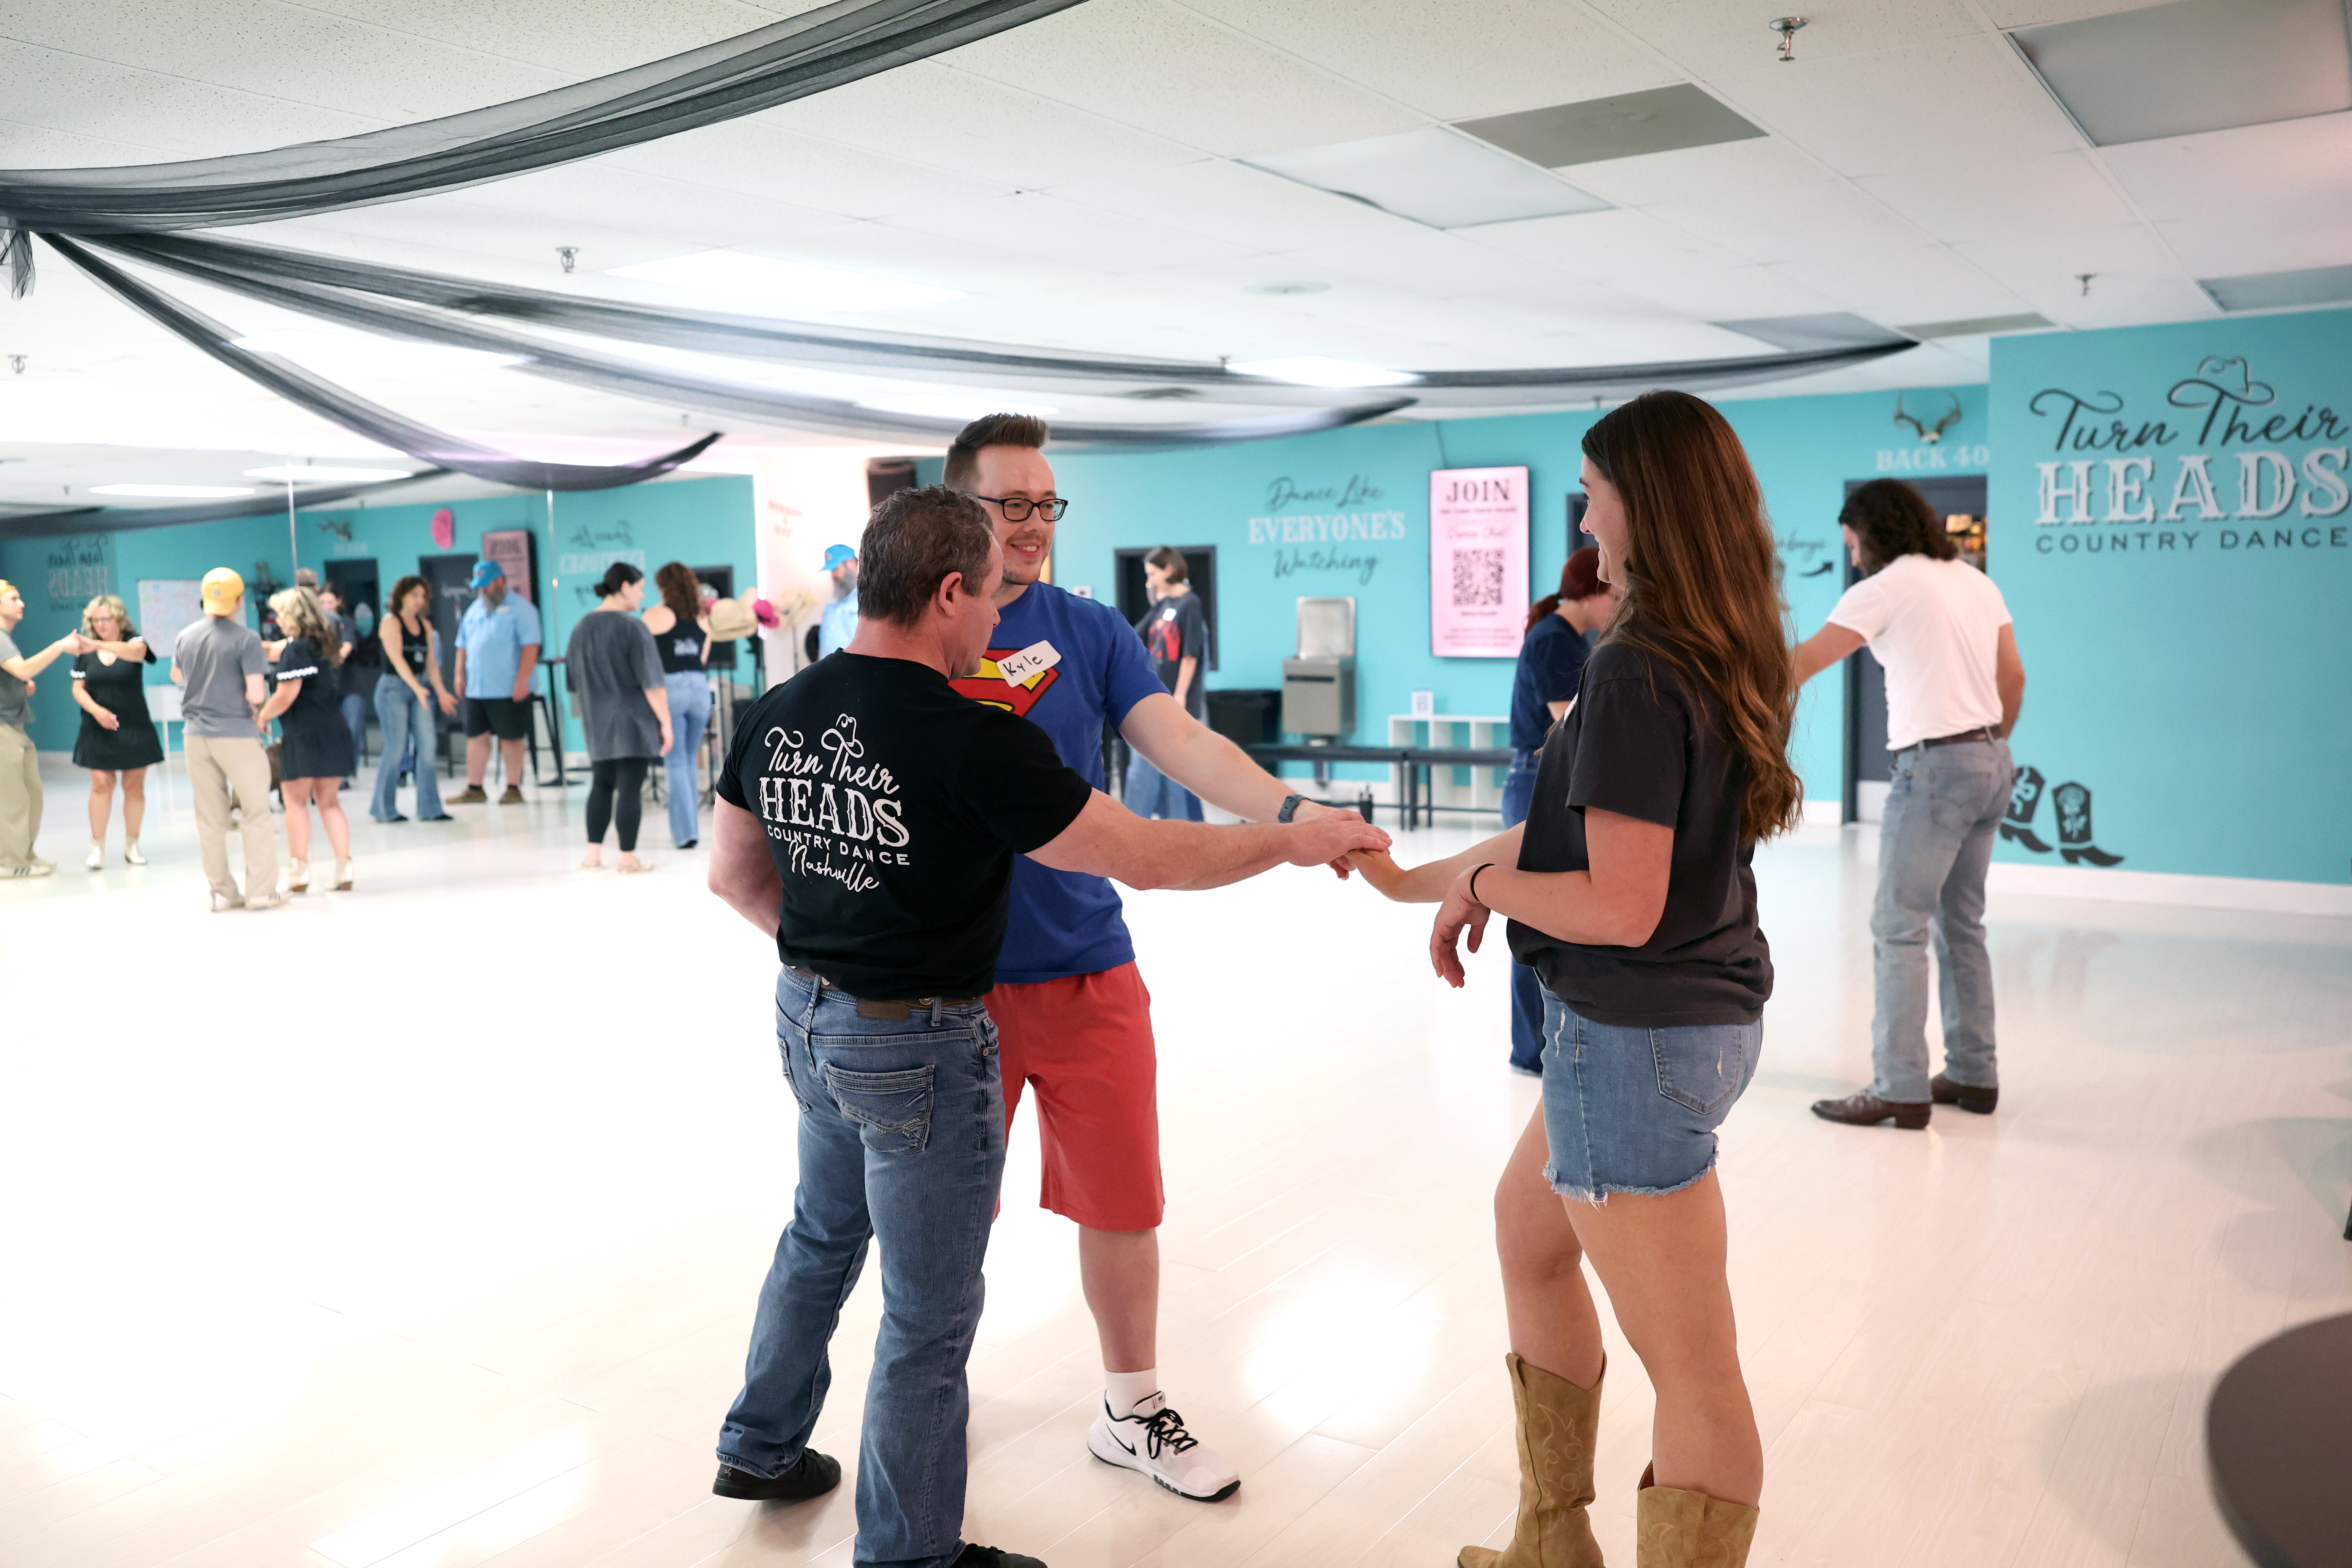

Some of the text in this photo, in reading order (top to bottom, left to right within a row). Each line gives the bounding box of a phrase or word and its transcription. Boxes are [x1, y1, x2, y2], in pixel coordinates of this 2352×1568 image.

[2030, 378, 2349, 452] Turn Their
[1876, 445, 1990, 471] BACK 40
[1263, 473, 1385, 512] Dance Like
[1446, 479, 1510, 503] JOIN
[2034, 446, 2351, 526] HEADS
[1249, 509, 1406, 544] EVERYONE'S
[2036, 527, 2348, 554] COUNTRY DANCE
[1274, 546, 1379, 585] Watching
[1002, 655, 1043, 676] Kyle
[764, 726, 900, 794] Turn Their
[759, 777, 909, 847] HEADS
[767, 824, 910, 866] COUNTRY DANCE
[788, 840, 879, 892] Nashville
